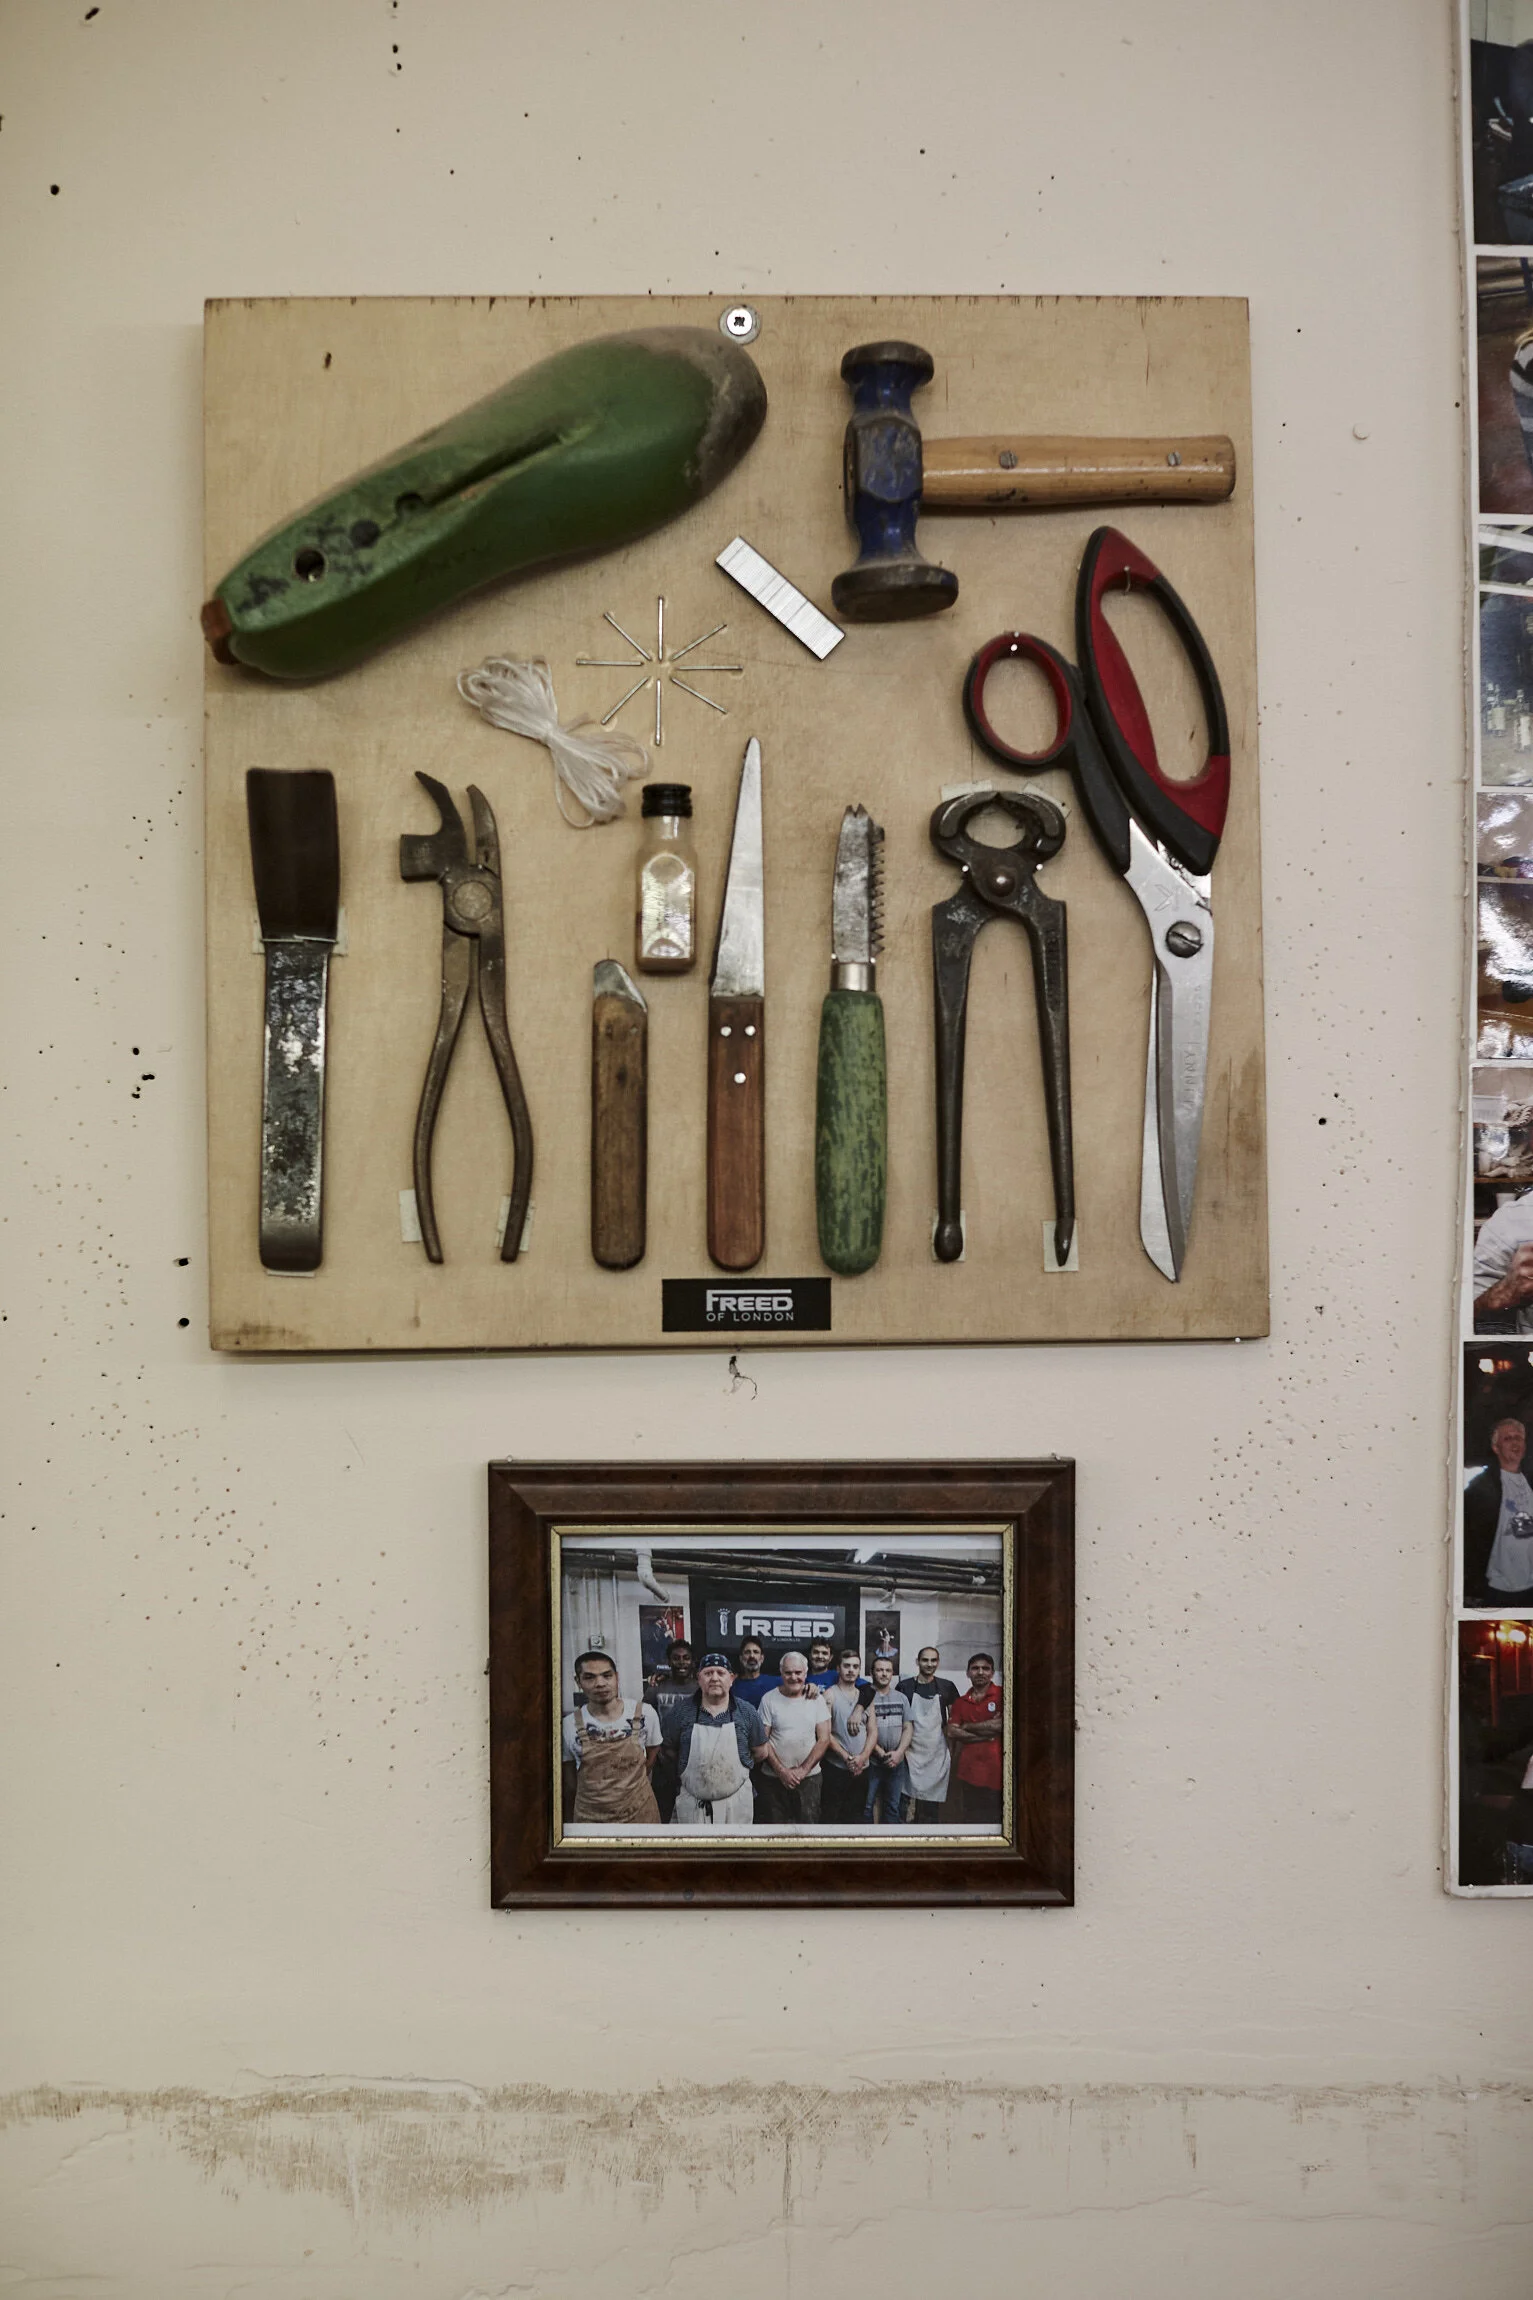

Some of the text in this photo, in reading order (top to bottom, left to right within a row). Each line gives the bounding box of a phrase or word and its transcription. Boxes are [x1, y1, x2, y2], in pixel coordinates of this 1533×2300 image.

[706, 1289, 793, 1312] FREED
[706, 1311, 794, 1322] OF LONDON
[735, 1609, 836, 1638] FREED
